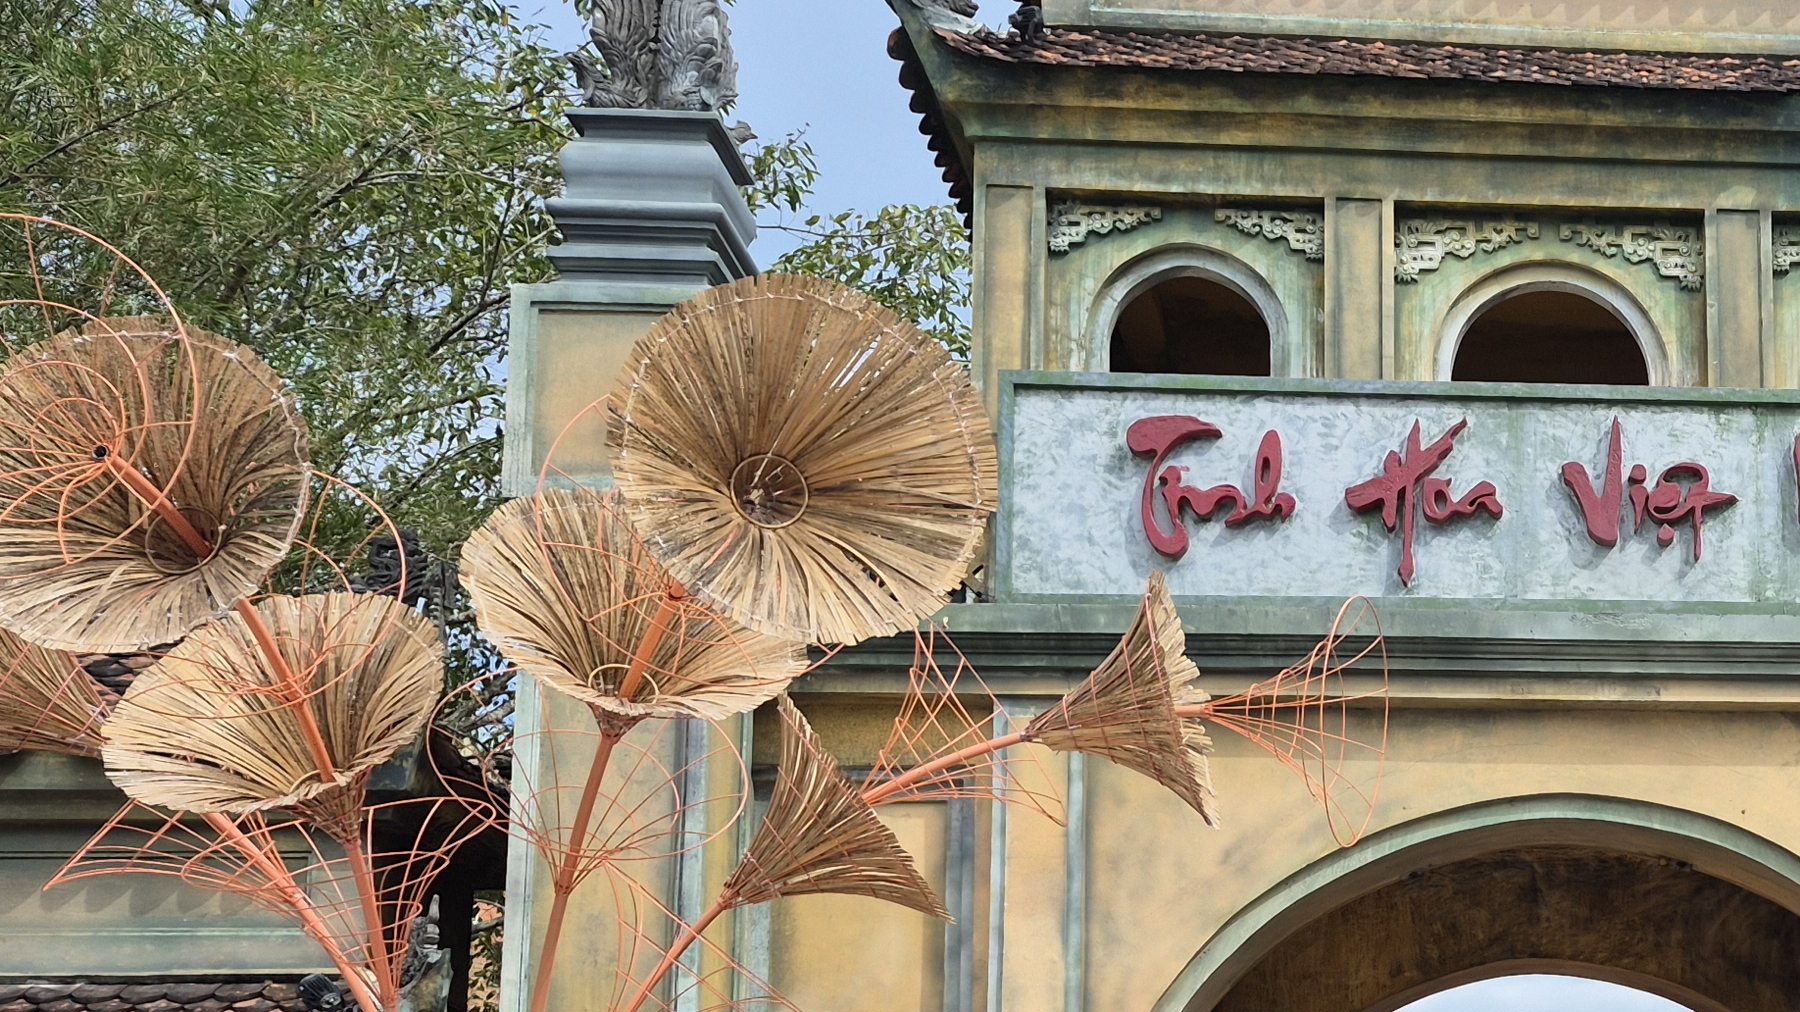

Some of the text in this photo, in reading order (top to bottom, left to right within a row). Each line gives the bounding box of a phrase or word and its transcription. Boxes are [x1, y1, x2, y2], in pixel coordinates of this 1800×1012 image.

[1127, 415, 1296, 560] Tinh
[1344, 417, 1504, 587] Hoa
[1562, 415, 1737, 563] Việt
